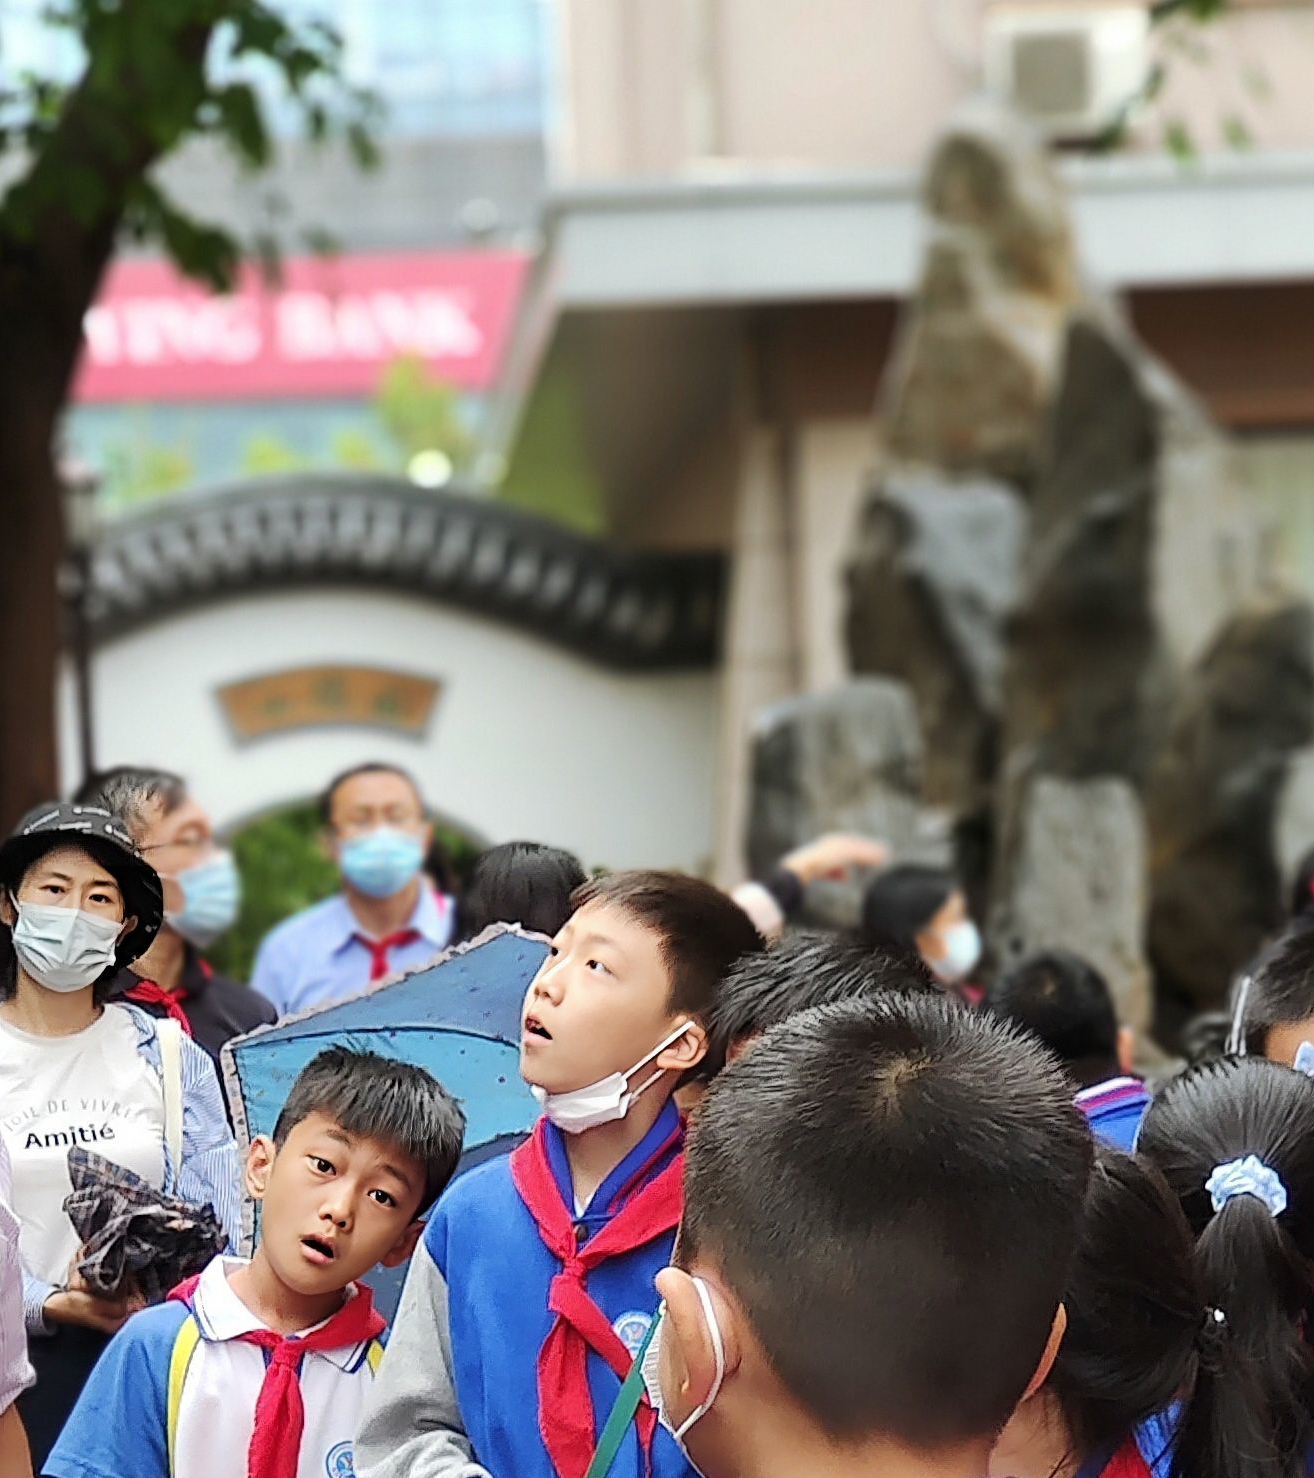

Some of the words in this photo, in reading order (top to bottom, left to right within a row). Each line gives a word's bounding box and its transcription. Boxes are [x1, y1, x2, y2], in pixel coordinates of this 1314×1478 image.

[277, 290, 482, 361] BANK
[48, 1099, 69, 1114] DE
[24, 1121, 115, 1149] Amitié
